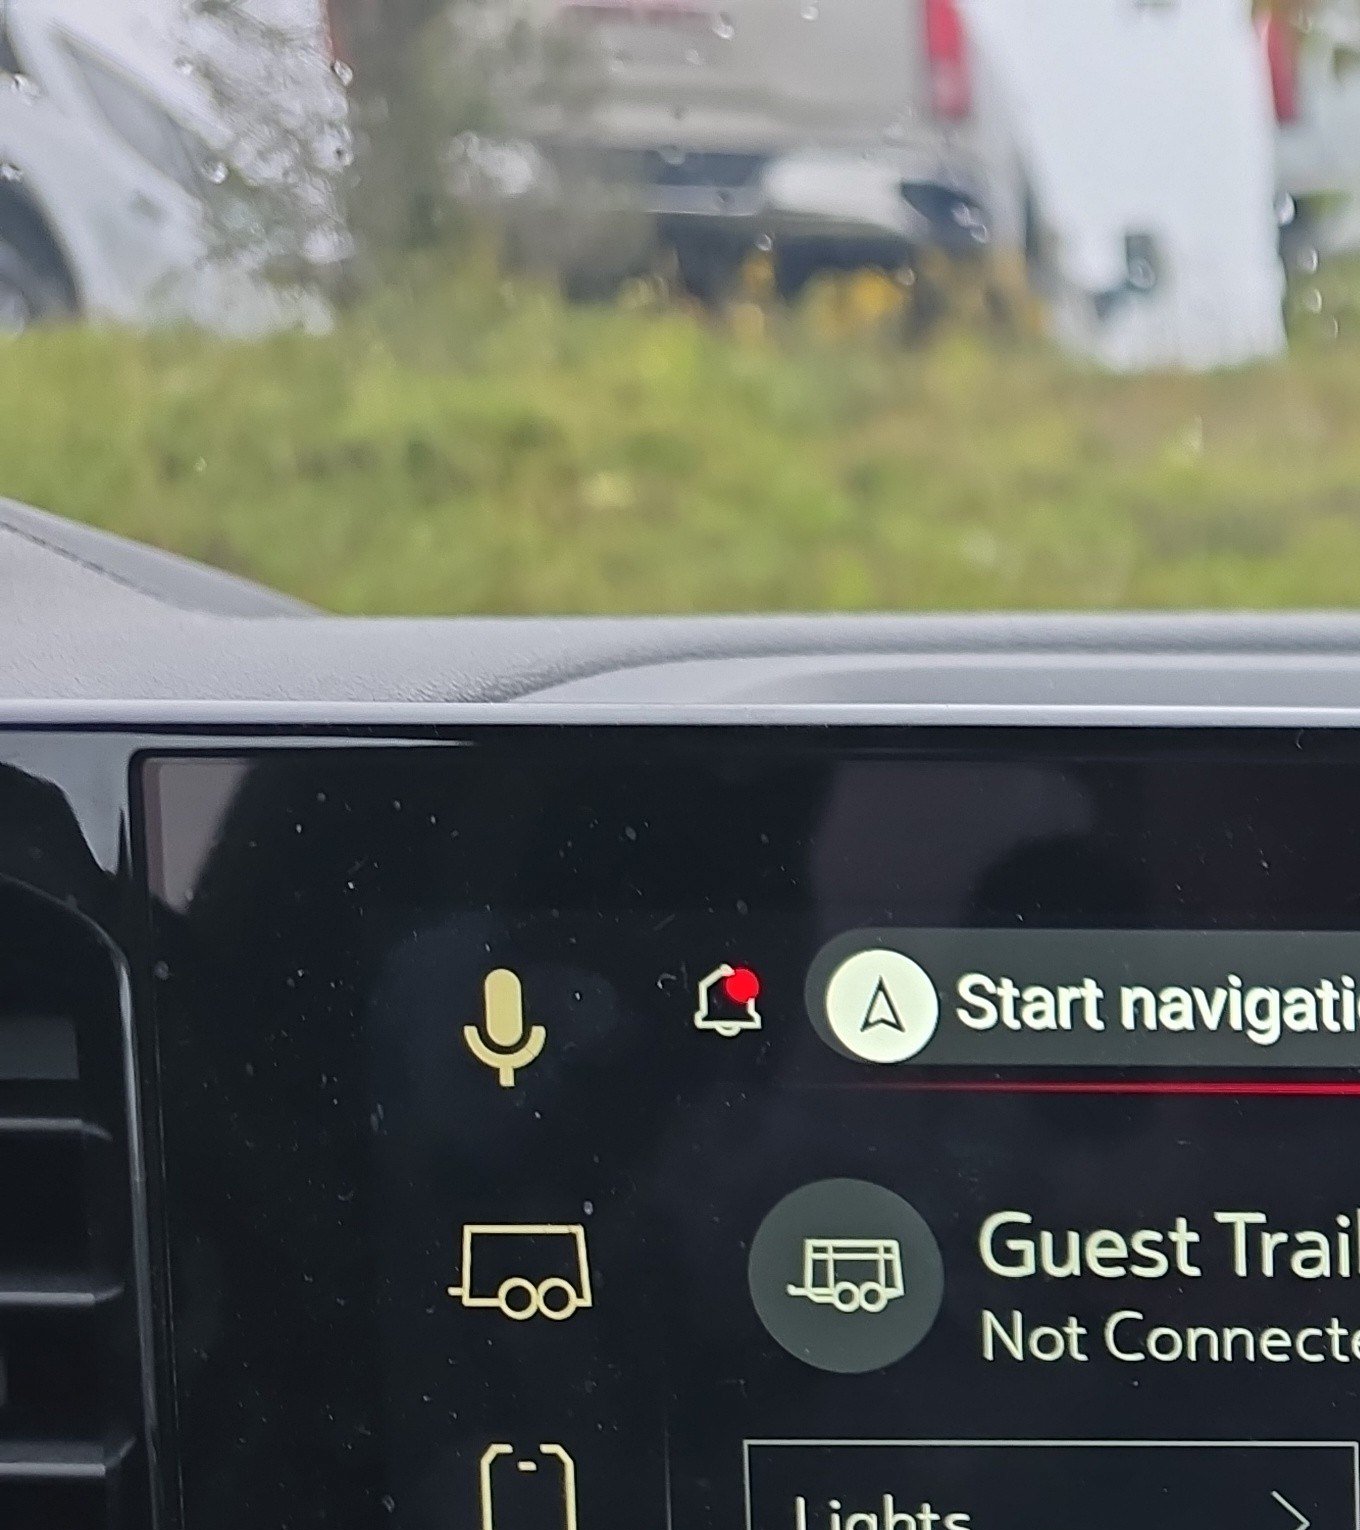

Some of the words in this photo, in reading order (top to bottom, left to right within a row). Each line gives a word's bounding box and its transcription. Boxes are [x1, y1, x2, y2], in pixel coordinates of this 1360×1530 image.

[956, 973, 1105, 1031] Start
[979, 1210, 1202, 1278] Guest
[982, 1309, 1089, 1362] Not
